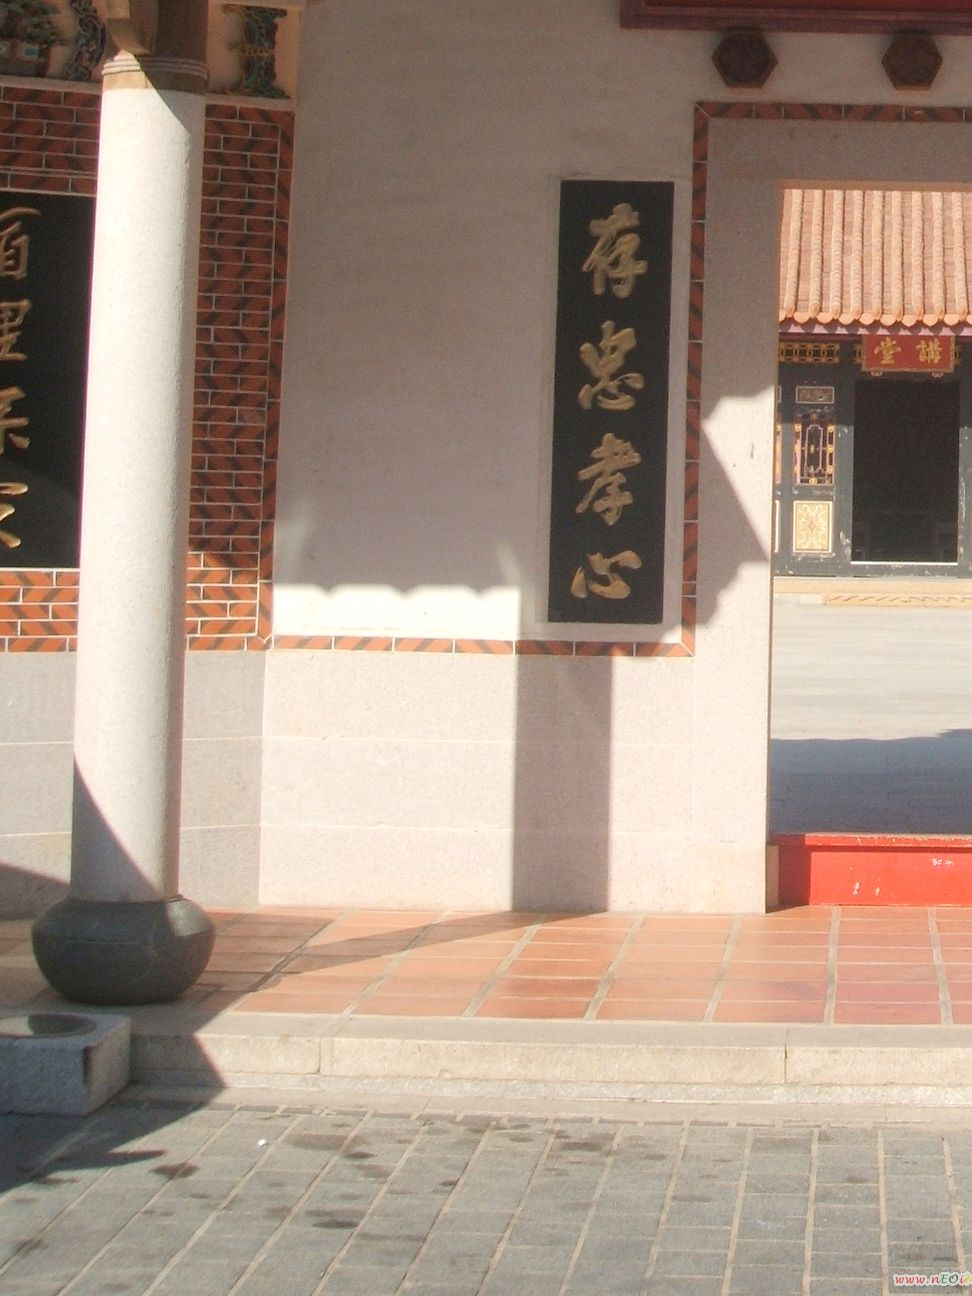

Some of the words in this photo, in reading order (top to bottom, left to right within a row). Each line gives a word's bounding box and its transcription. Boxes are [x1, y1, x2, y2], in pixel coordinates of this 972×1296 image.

[571, 203, 647, 599] 存忠孝心
[874, 336, 942, 364] 講堂
